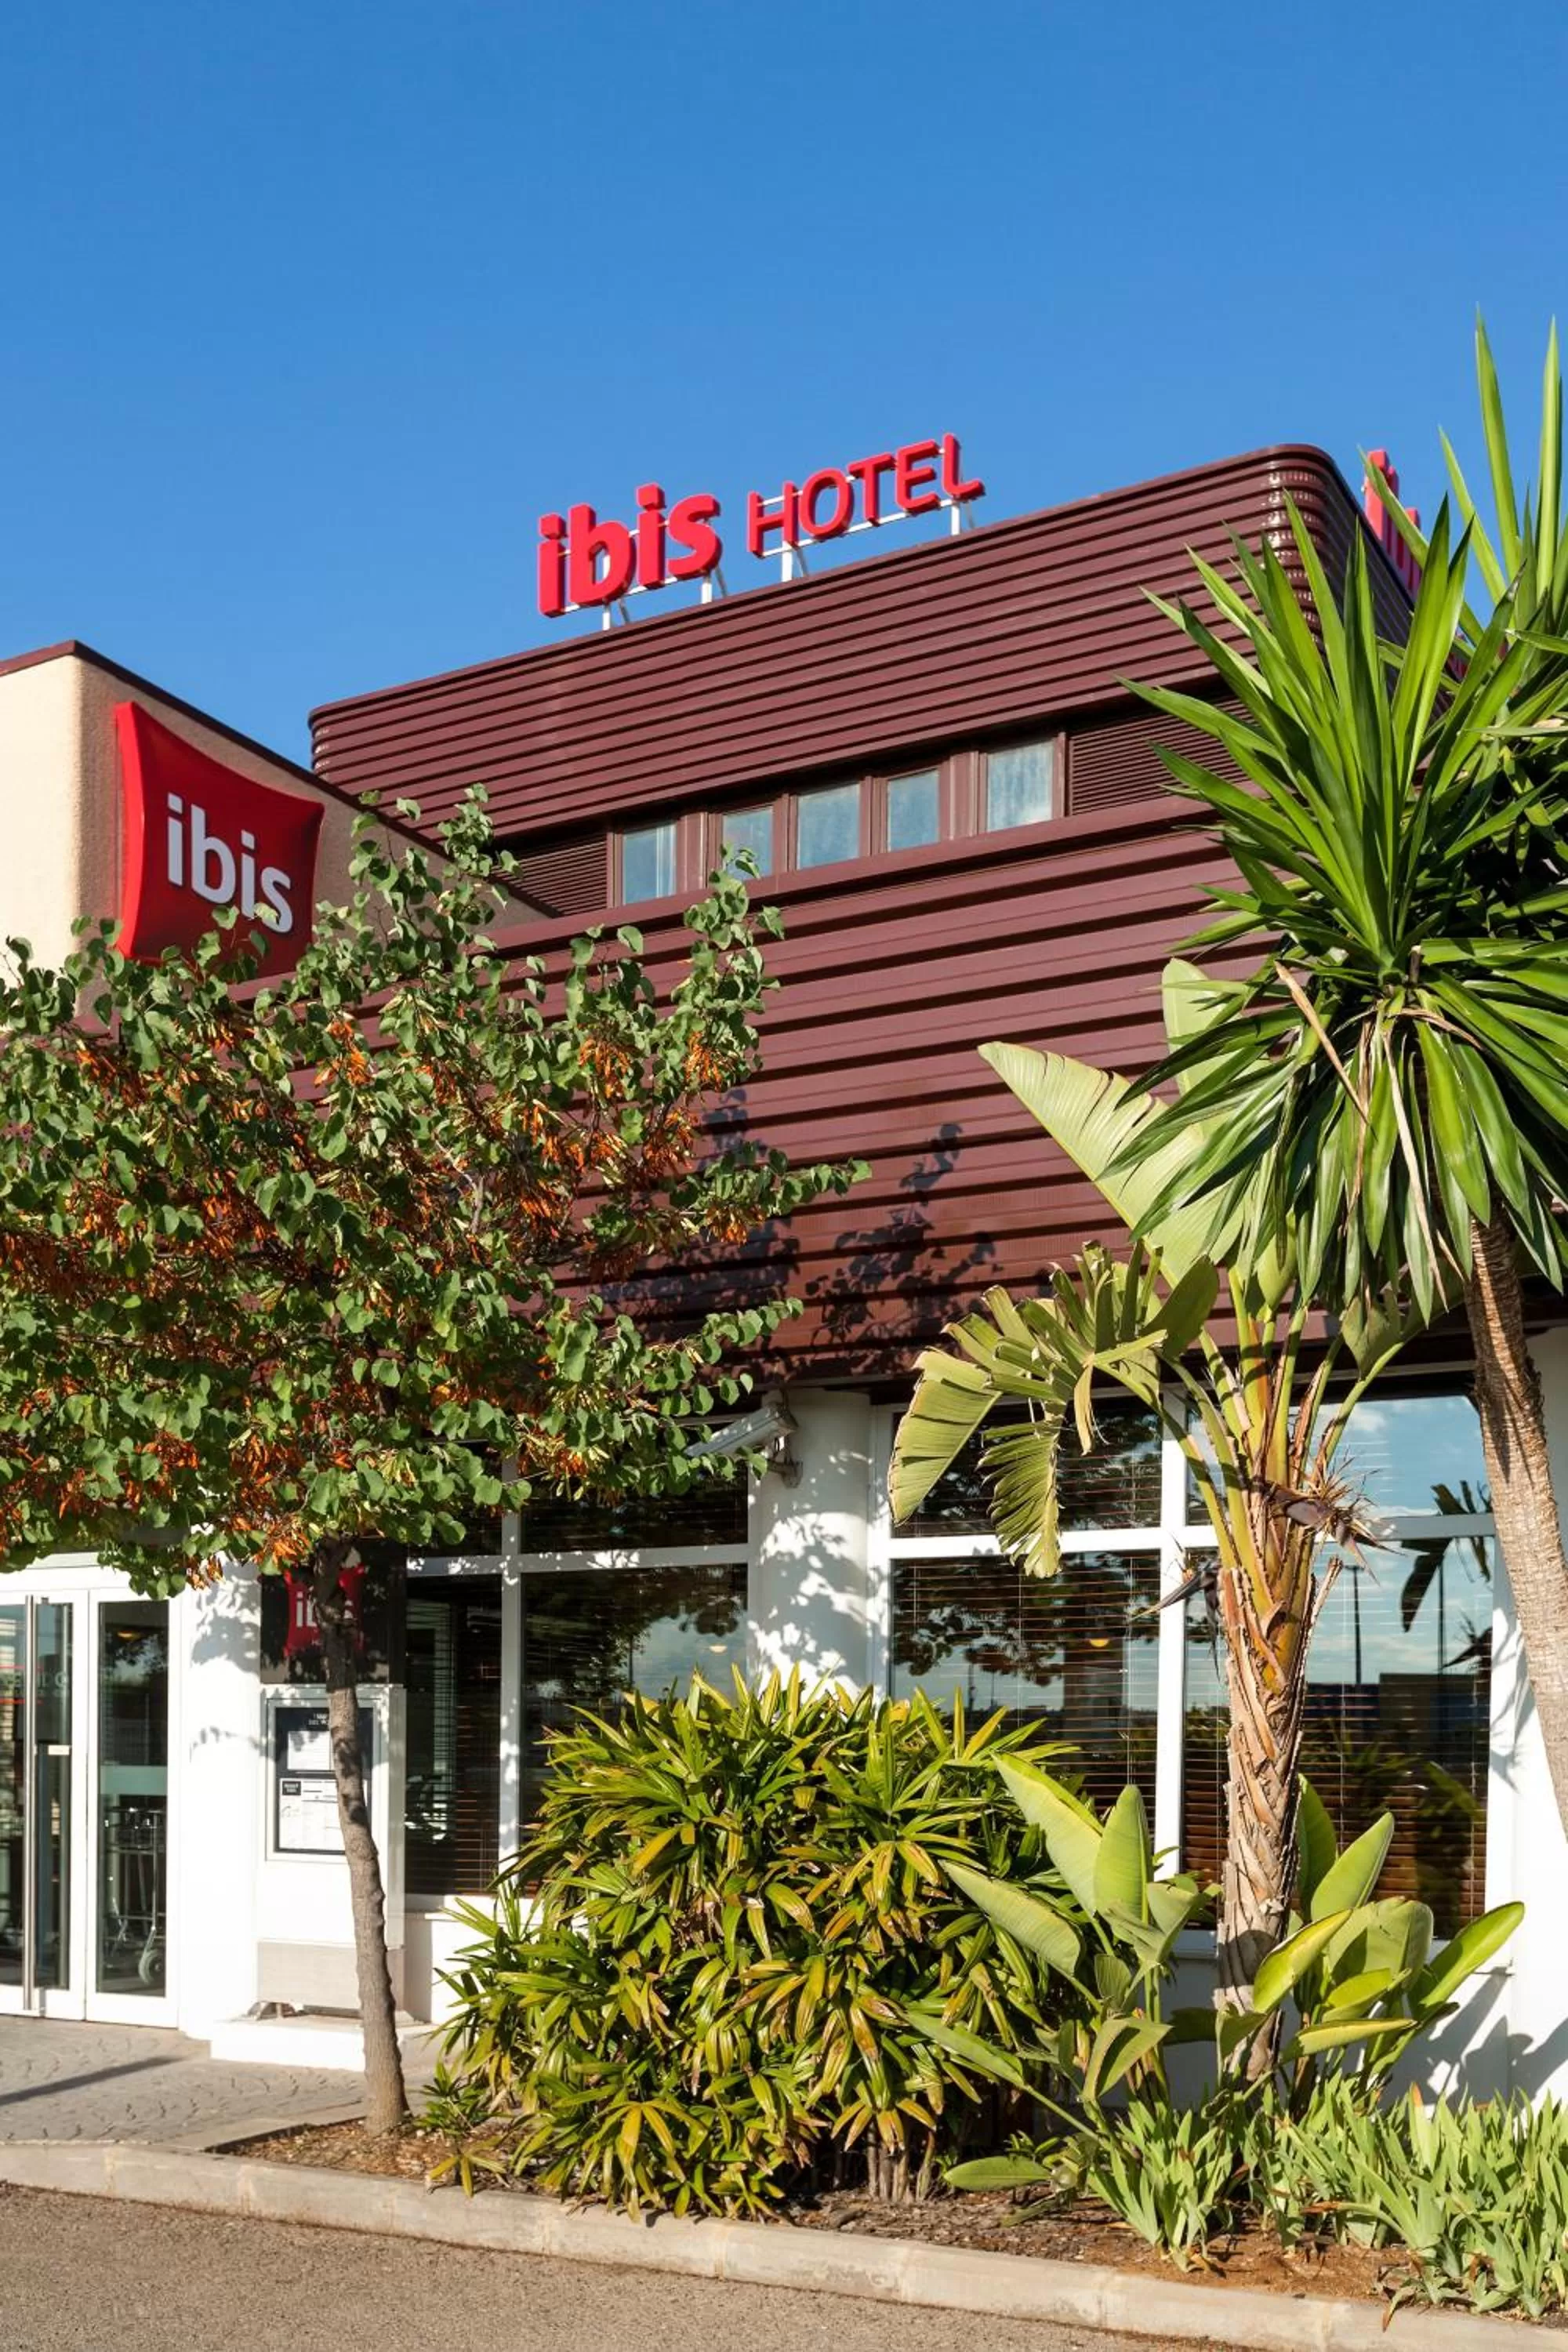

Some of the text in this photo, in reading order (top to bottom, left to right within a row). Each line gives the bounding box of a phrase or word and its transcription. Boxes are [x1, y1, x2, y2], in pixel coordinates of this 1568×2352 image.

[539, 433, 985, 617] ibis HOTEL
[168, 792, 293, 933] ibis
